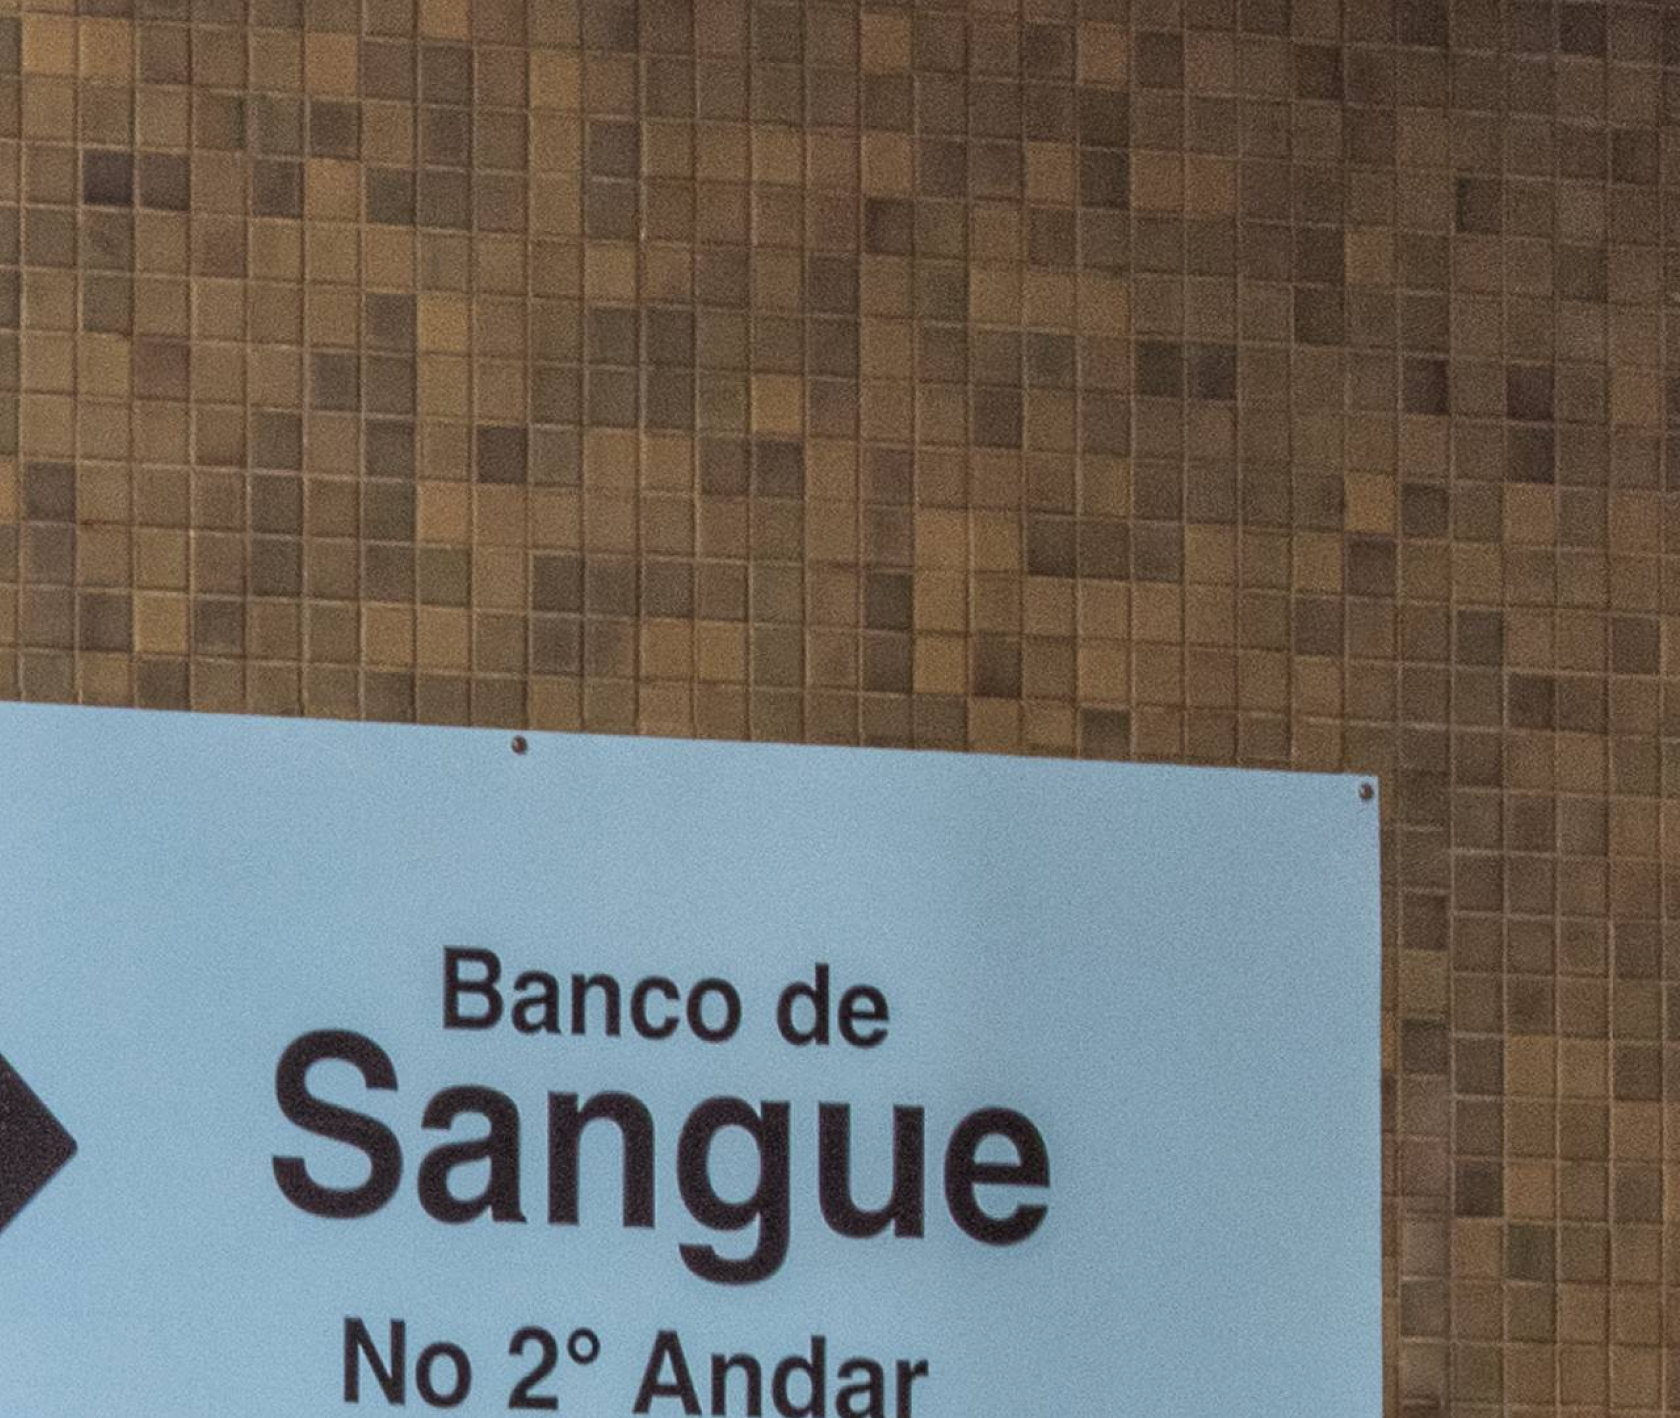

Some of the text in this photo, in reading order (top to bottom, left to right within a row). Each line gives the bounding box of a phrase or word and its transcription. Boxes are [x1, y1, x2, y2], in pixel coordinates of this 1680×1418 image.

[443, 945, 890, 1050] Banco de
[272, 1027, 1051, 1286] Sangue
[343, 1316, 473, 1409] No
